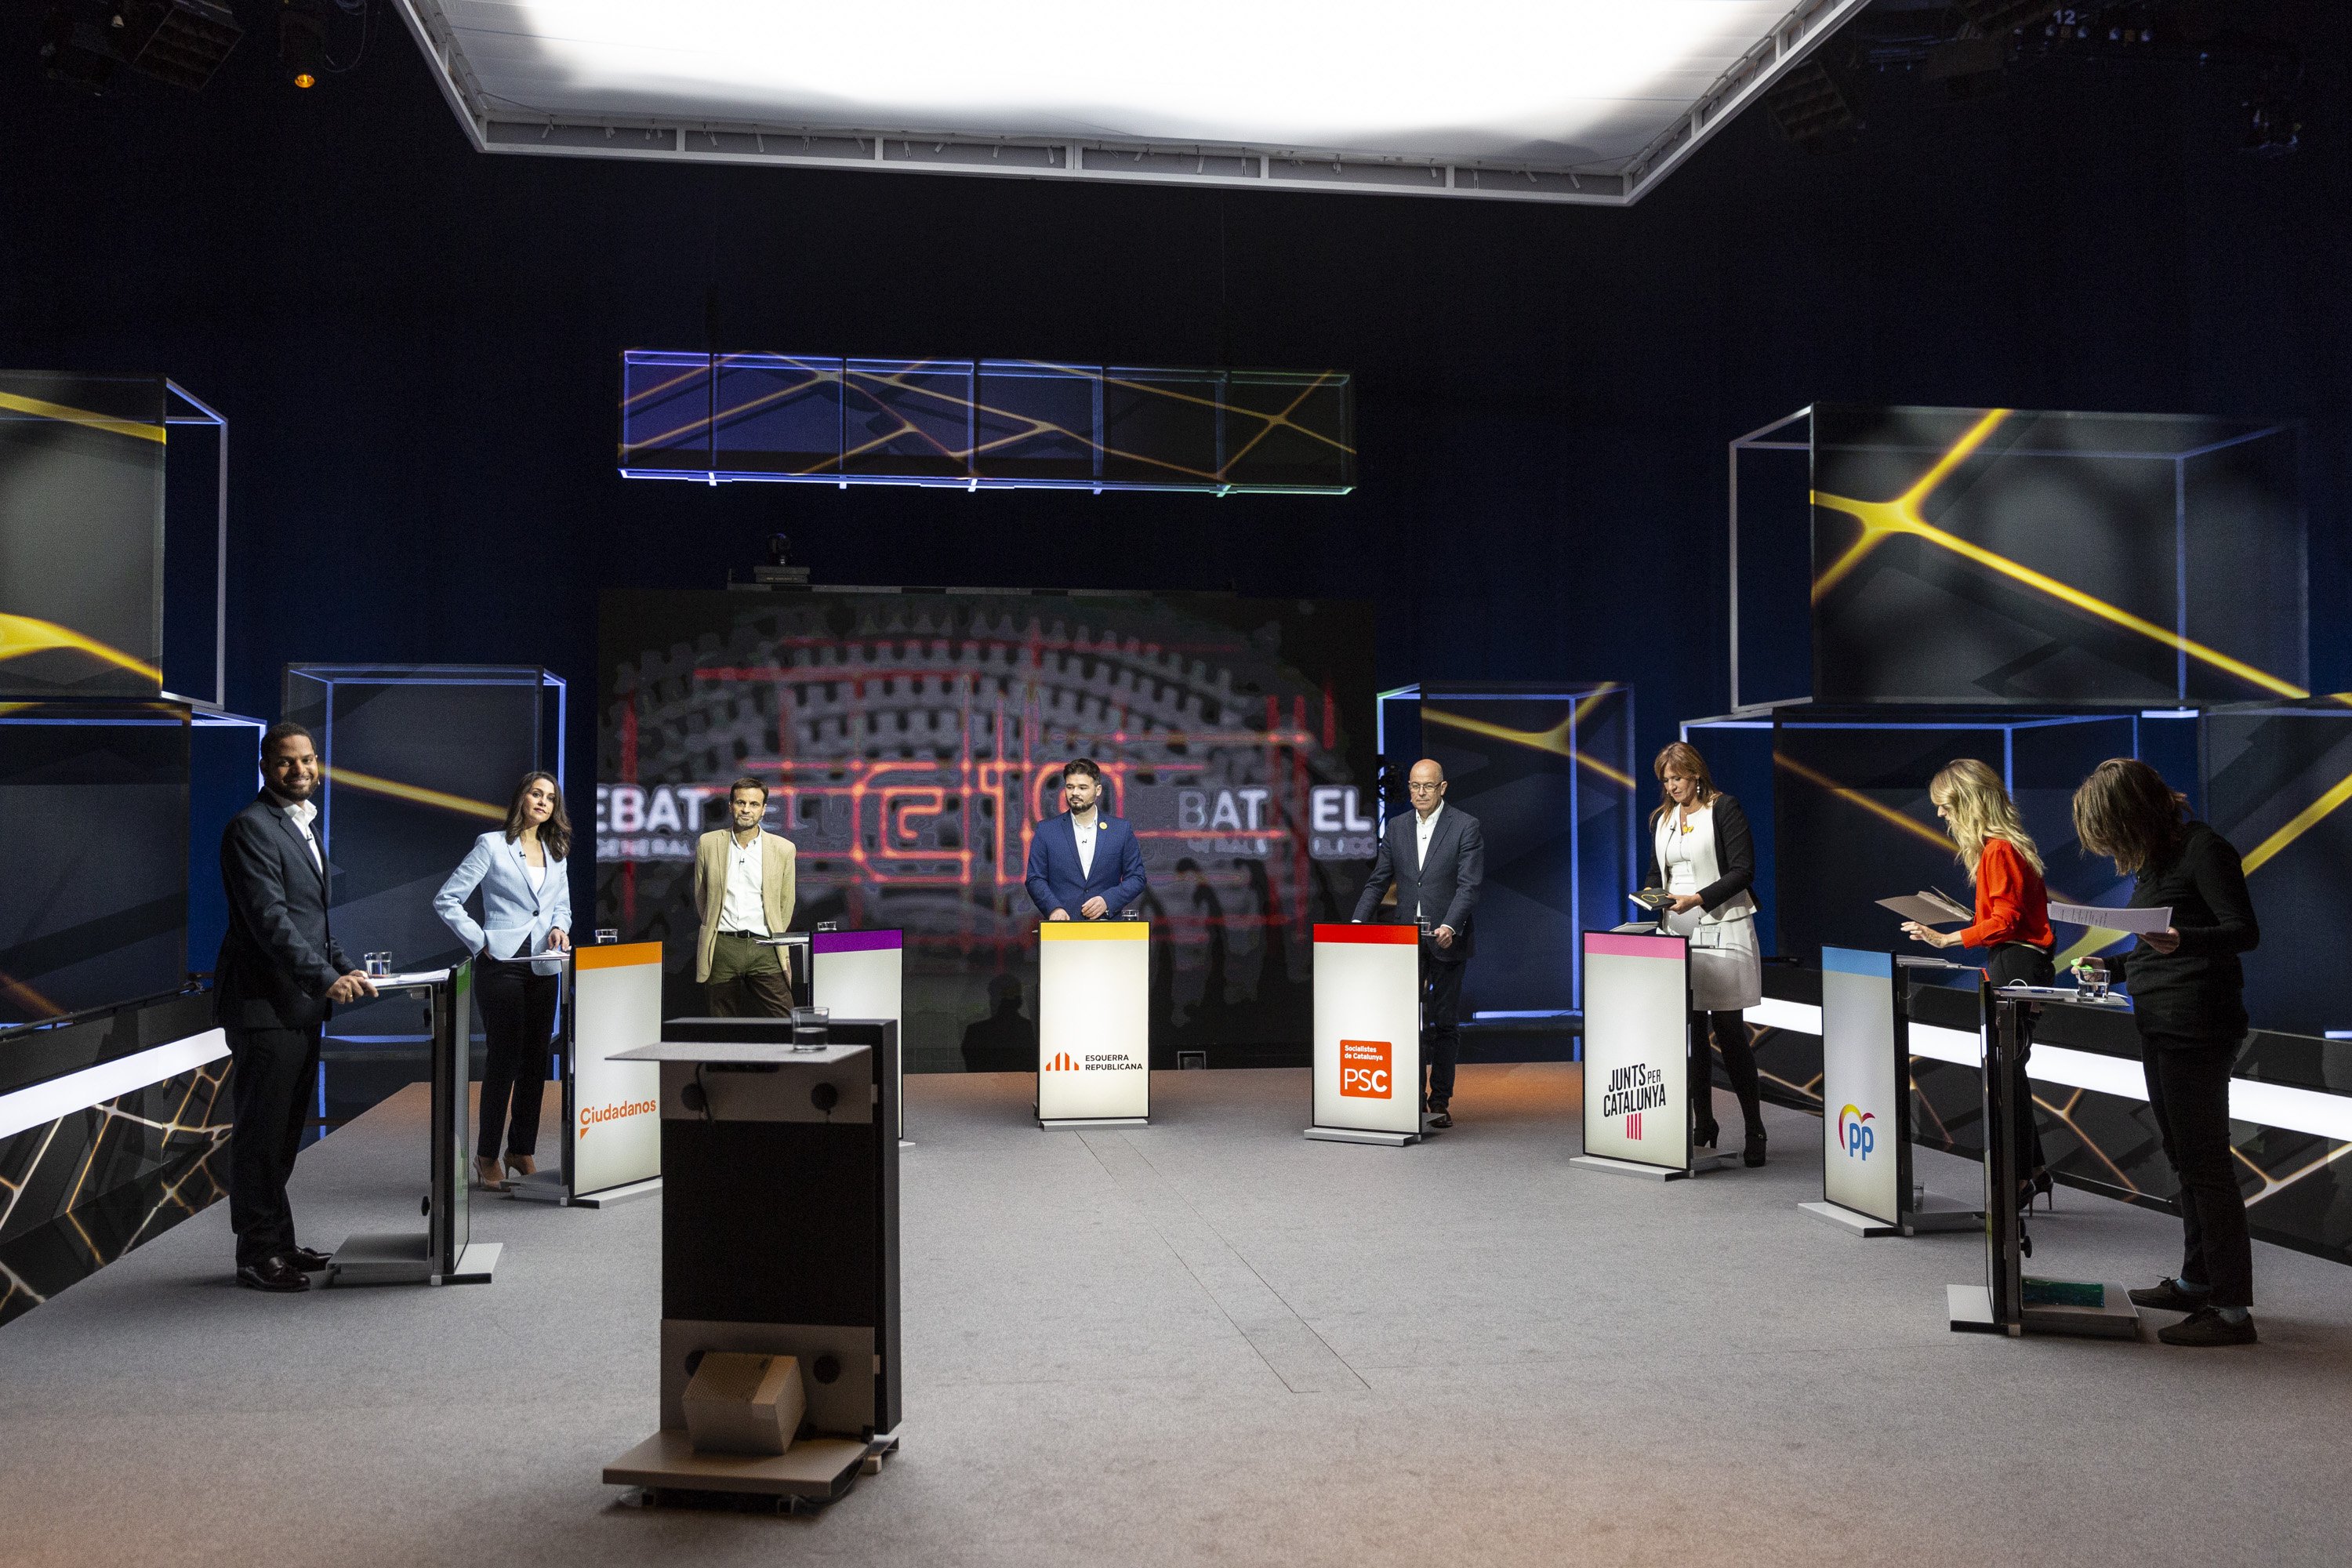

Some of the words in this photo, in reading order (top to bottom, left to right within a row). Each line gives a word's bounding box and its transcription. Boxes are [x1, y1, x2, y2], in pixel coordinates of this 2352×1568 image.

[2053, 9, 2076, 26] 12
[1313, 789, 1372, 831] EL
[1353, 1053, 1383, 1062] Catalunya
[1344, 1068, 1388, 1093] PSC
[1608, 1062, 1646, 1092] JUNTS
[1647, 1069, 1661, 1084] PER
[580, 1099, 656, 1125] Ciudadanos
[1603, 1083, 1666, 1118] CATALUNYA
